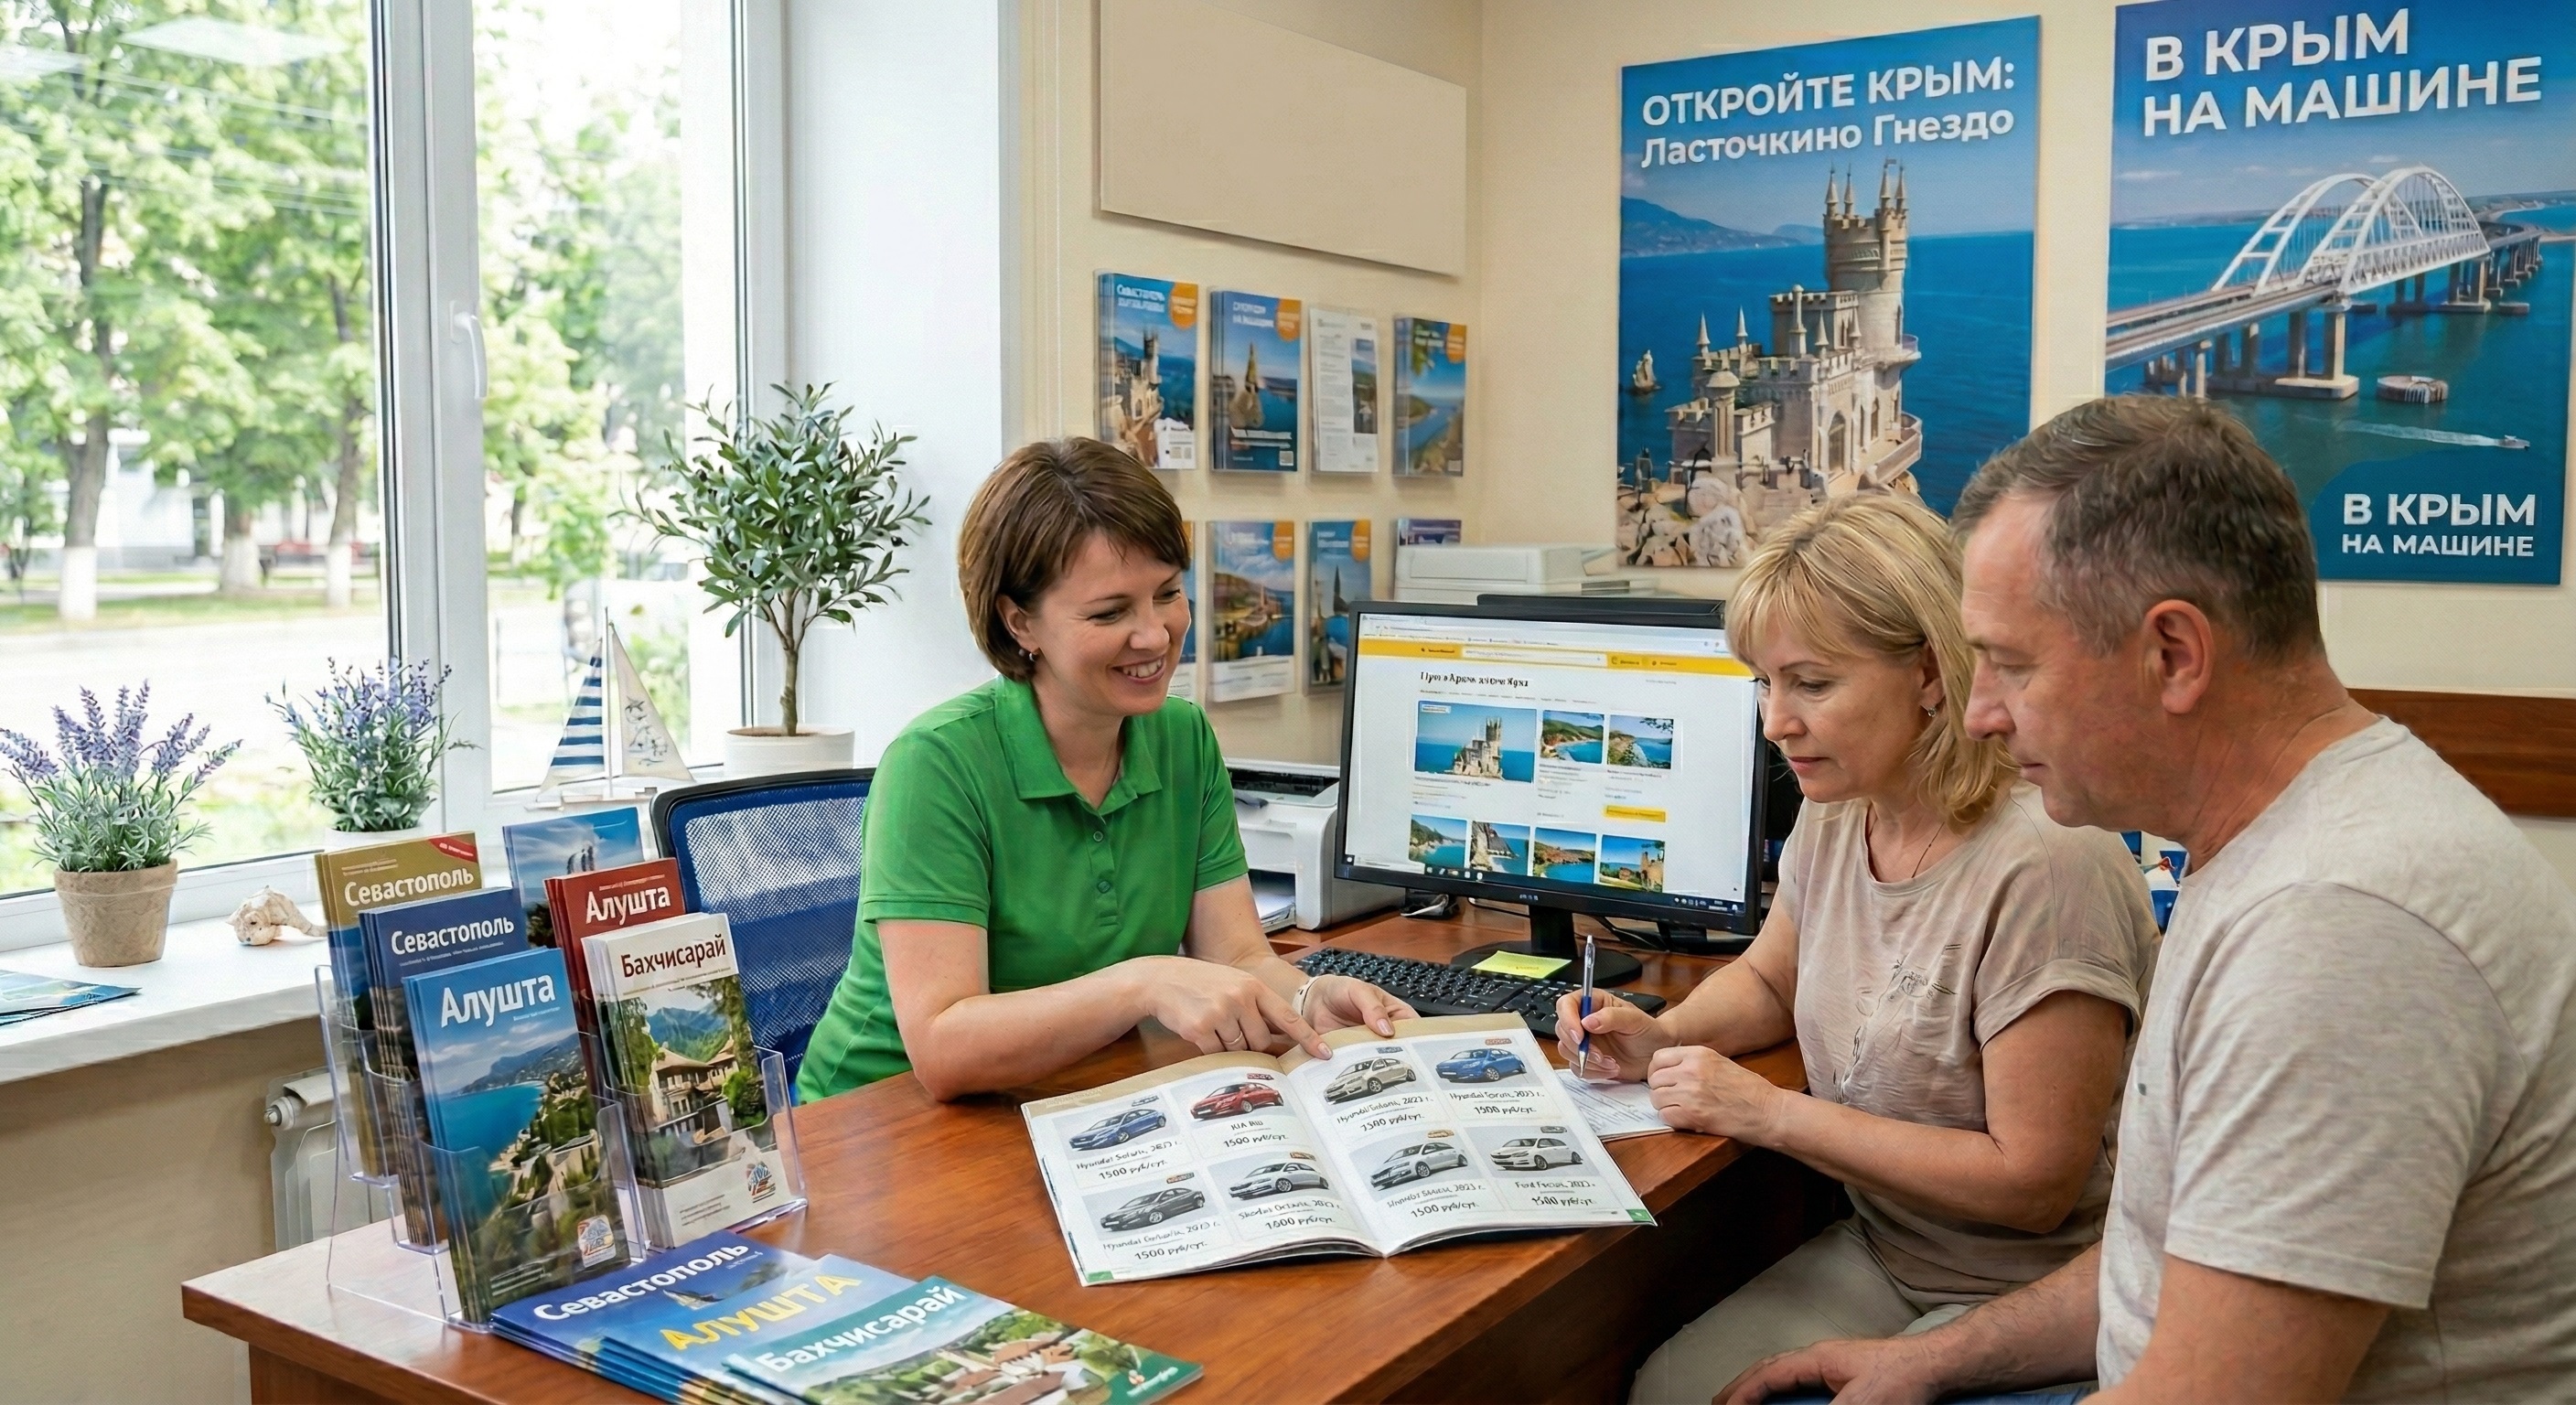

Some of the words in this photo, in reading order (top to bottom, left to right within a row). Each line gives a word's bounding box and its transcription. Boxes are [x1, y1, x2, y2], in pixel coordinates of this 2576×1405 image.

[2145, 35, 2184, 82] В
[2205, 7, 2410, 76] КРЫМ
[1642, 72, 1855, 126] ОТКРОЙТЕ
[1868, 56, 2015, 103] КРЫМ:
[2143, 91, 2227, 137] НА
[2245, 56, 2542, 128] МАШИНЕ
[1640, 125, 1862, 168] Ласточкино
[1873, 109, 2014, 146] Гнездо
[2343, 493, 2373, 525] В
[2387, 493, 2537, 526] КРЫМ
[2342, 533, 2385, 554] НА
[2392, 534, 2535, 557] МАШИНЕ
[344, 867, 475, 906] Севастополь
[585, 885, 671, 926] Алушта
[391, 916, 515, 956] Севастополь
[620, 933, 727, 978] Бахчисарай
[440, 973, 556, 1028] Алушта
[1099, 1166, 1128, 1181] 1500
[1411, 1204, 1440, 1218] 1500
[1134, 1248, 1165, 1260] 1500
[533, 1242, 750, 1321] Севастополь
[659, 1273, 864, 1351] АЛУШТА
[754, 1285, 968, 1373] Бахчисарай
